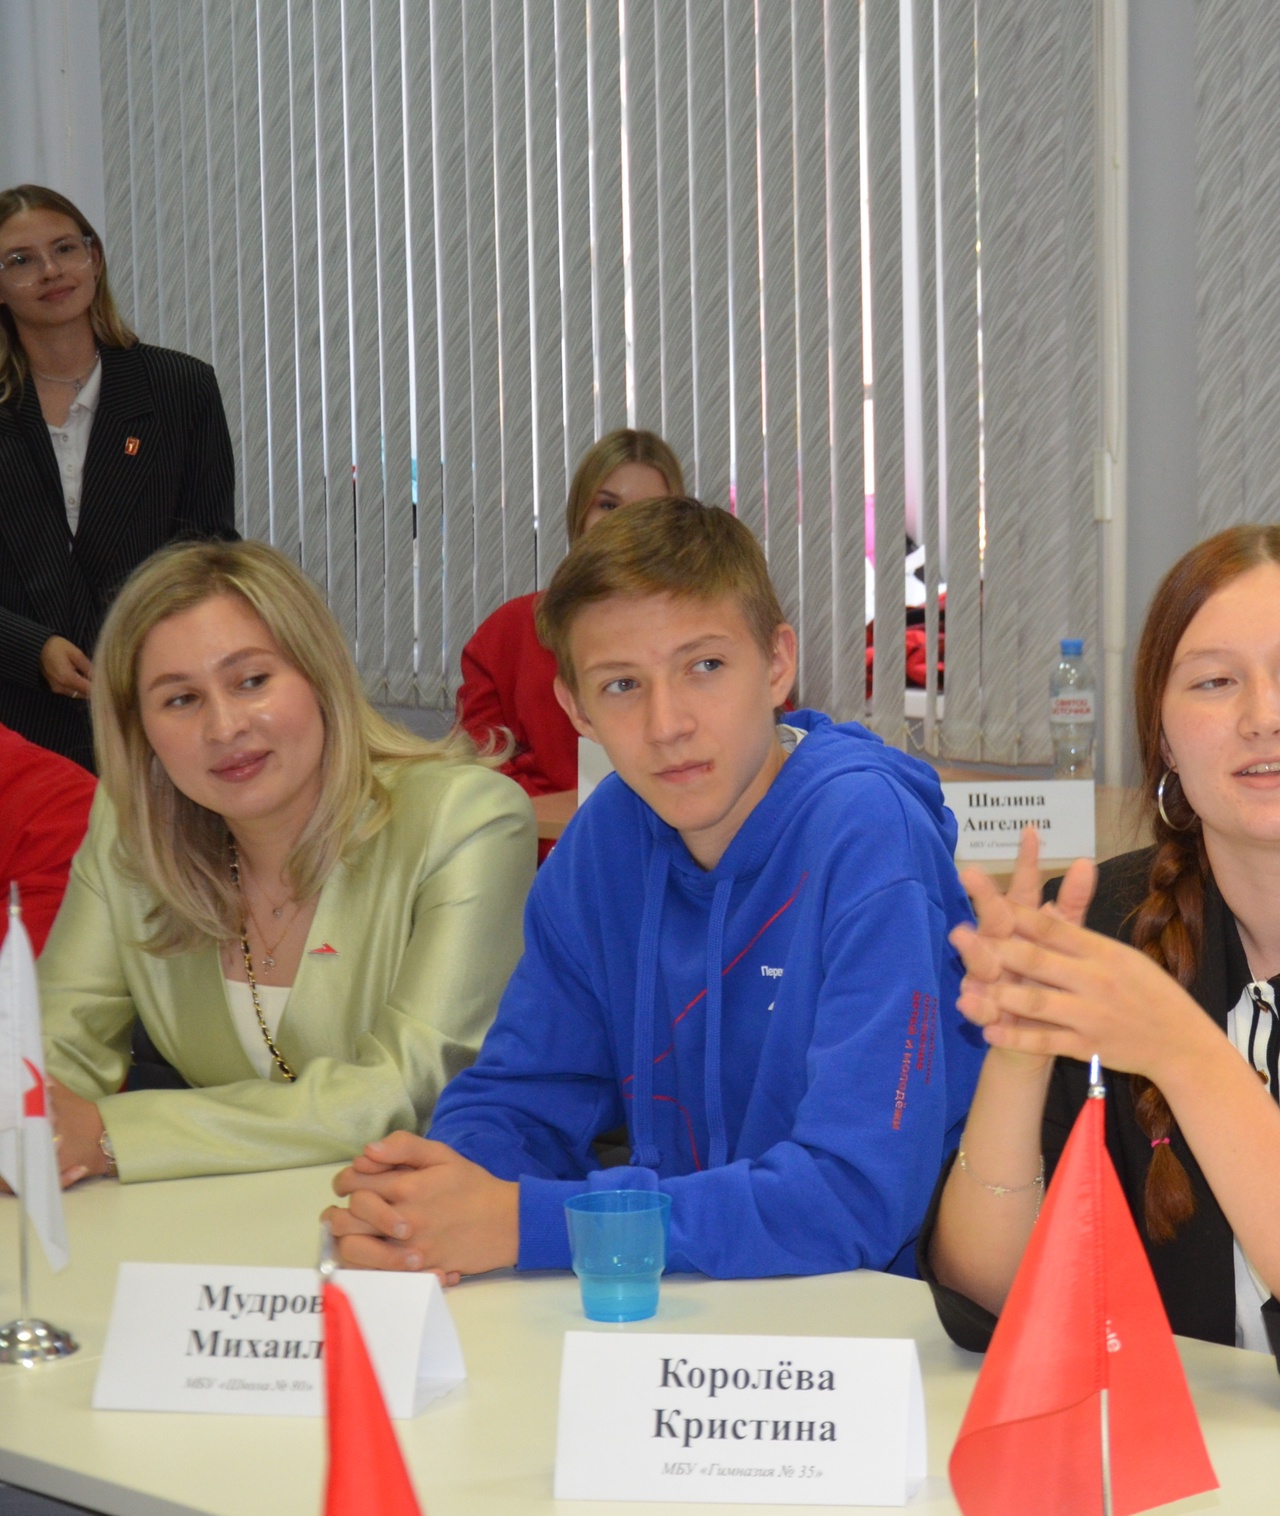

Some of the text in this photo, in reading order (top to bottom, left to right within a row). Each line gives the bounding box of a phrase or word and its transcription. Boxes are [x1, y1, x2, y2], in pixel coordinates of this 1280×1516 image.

[968, 793, 1046, 808] Шилина
[963, 817, 1052, 832] Ангелина
[197, 1284, 325, 1321] Мудров
[185, 1329, 324, 1360] Михаил
[658, 1357, 836, 1398] Королёва
[651, 1408, 838, 1448] Кристина
[661, 1462, 824, 1479] МБУ «Гимназия № 35»
